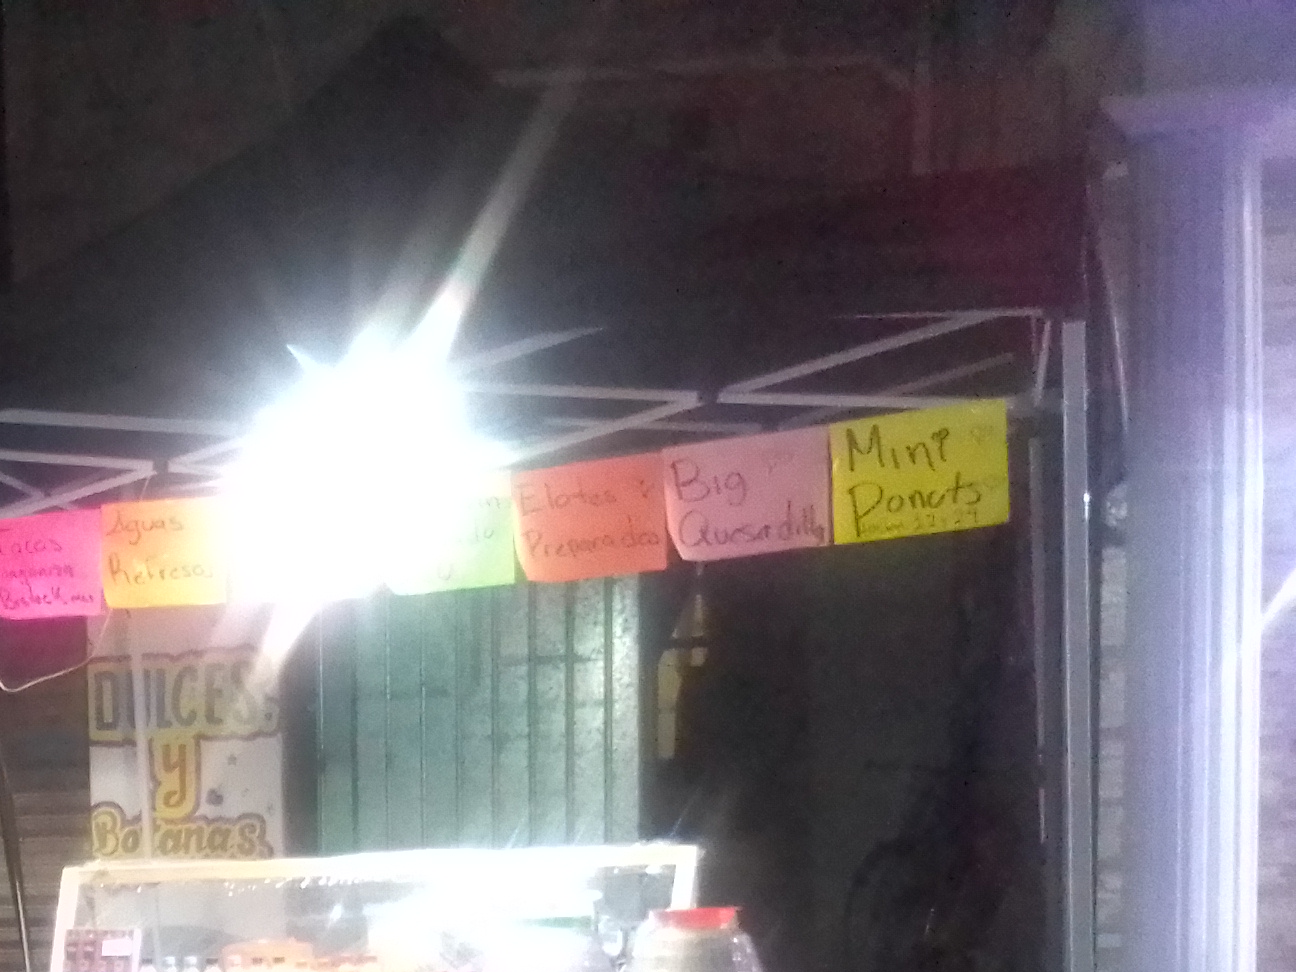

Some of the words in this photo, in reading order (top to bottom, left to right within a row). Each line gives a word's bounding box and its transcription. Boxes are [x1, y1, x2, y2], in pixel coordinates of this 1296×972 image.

[846, 424, 950, 472] Mini
[670, 458, 748, 506] Big
[106, 510, 185, 545] Aguas
[94, 811, 257, 857] Boanas
